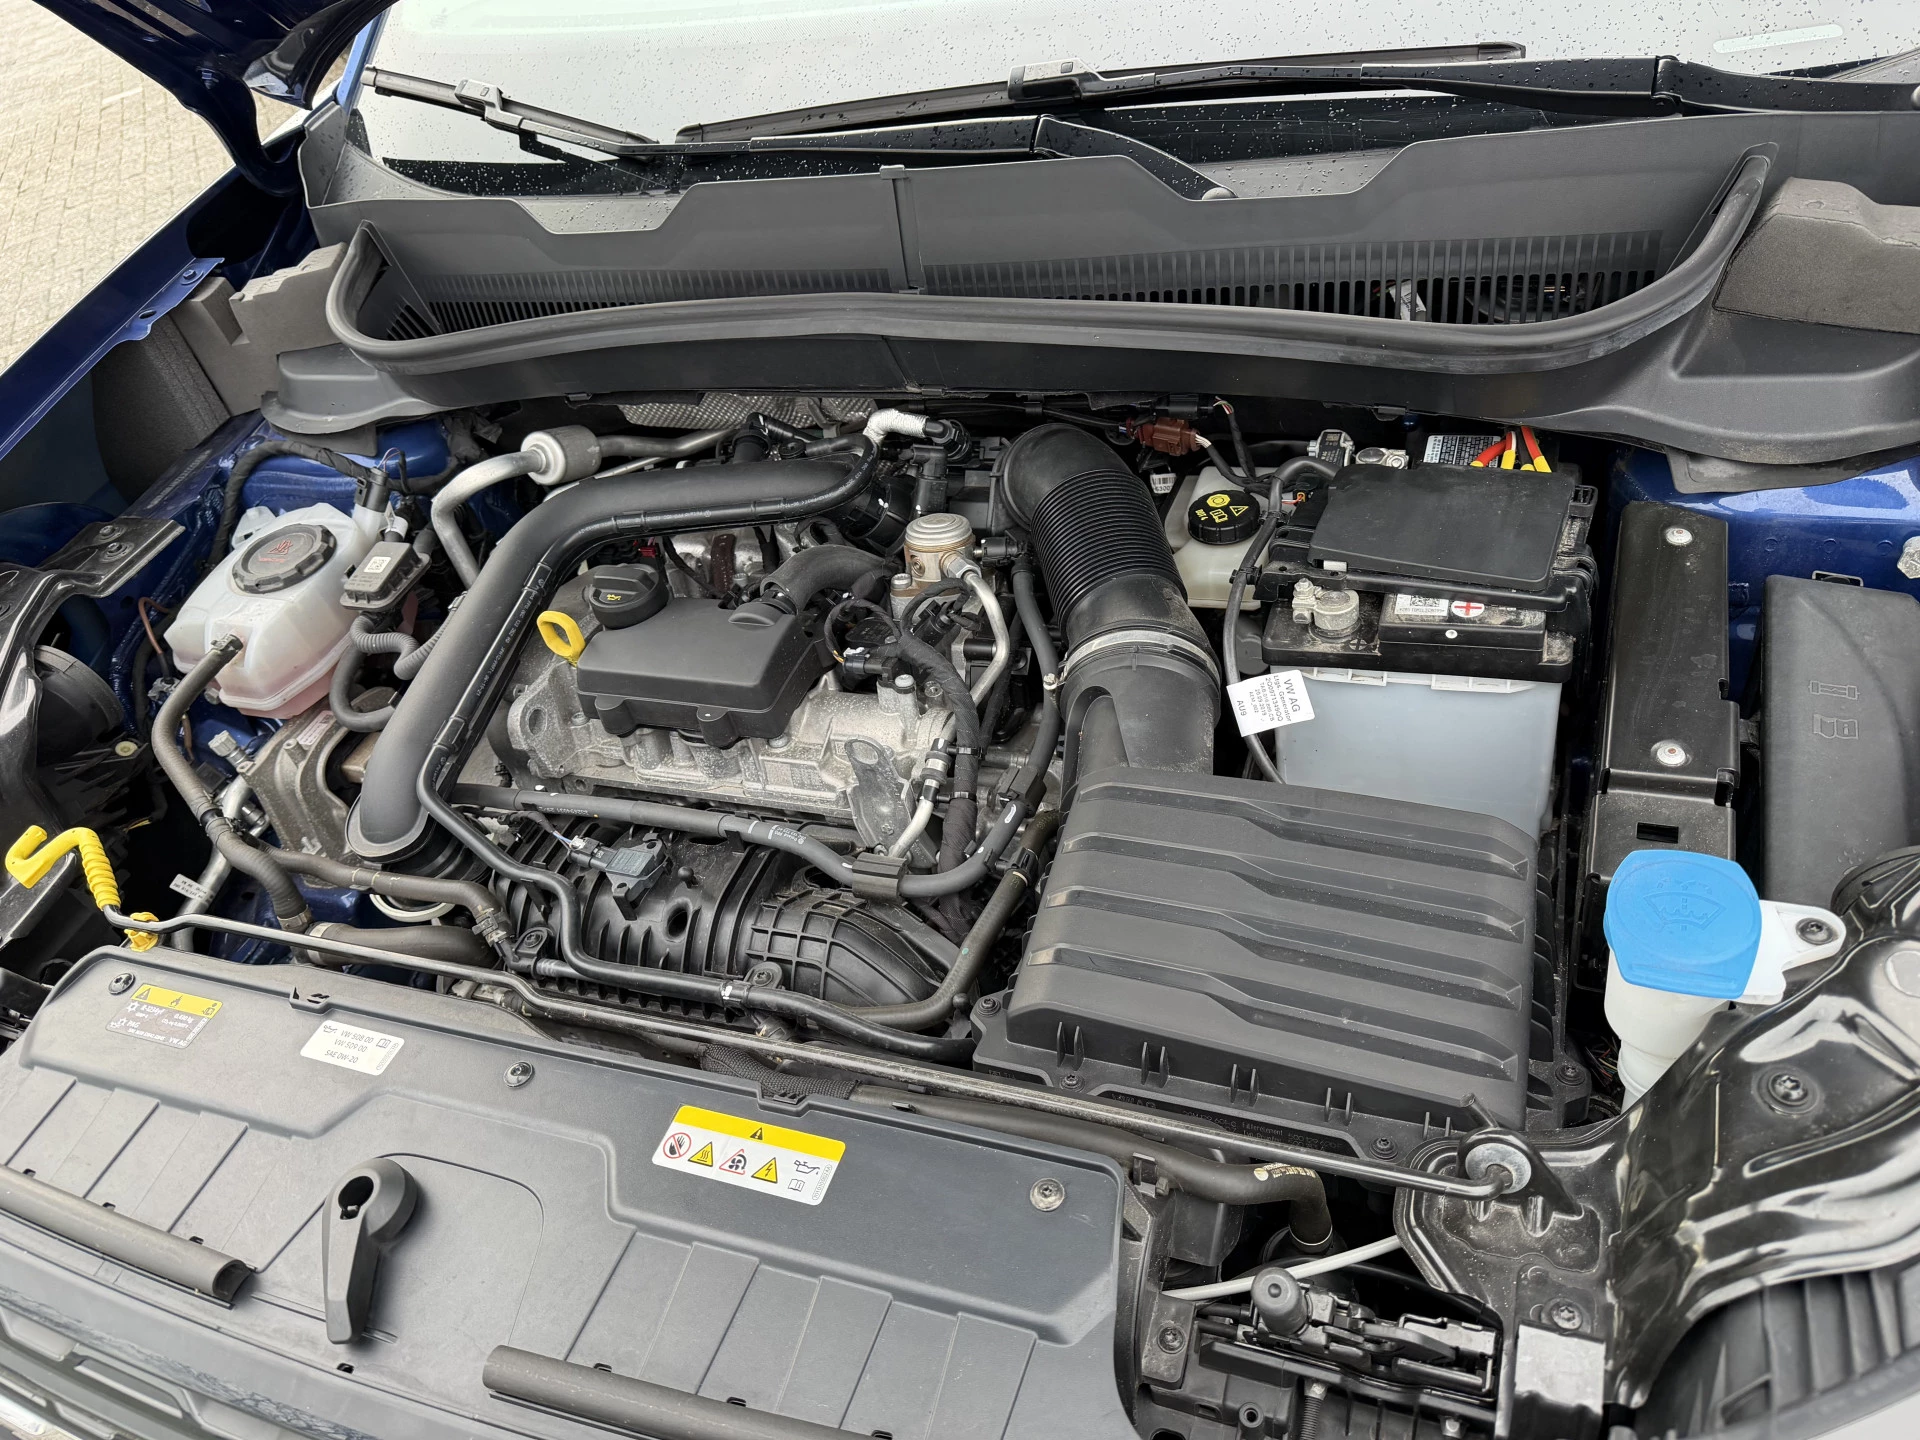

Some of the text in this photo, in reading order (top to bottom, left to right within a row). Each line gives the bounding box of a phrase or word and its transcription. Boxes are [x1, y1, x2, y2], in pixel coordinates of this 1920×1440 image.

[1284, 678, 1301, 713] VW AG
[1278, 691, 1292, 722] Generator
[126, 1020, 141, 1029] PAG
[340, 1030, 375, 1044] VW 508 00
[334, 1038, 368, 1053] VW 509 00
[324, 1049, 359, 1064] SAE 0W-20
